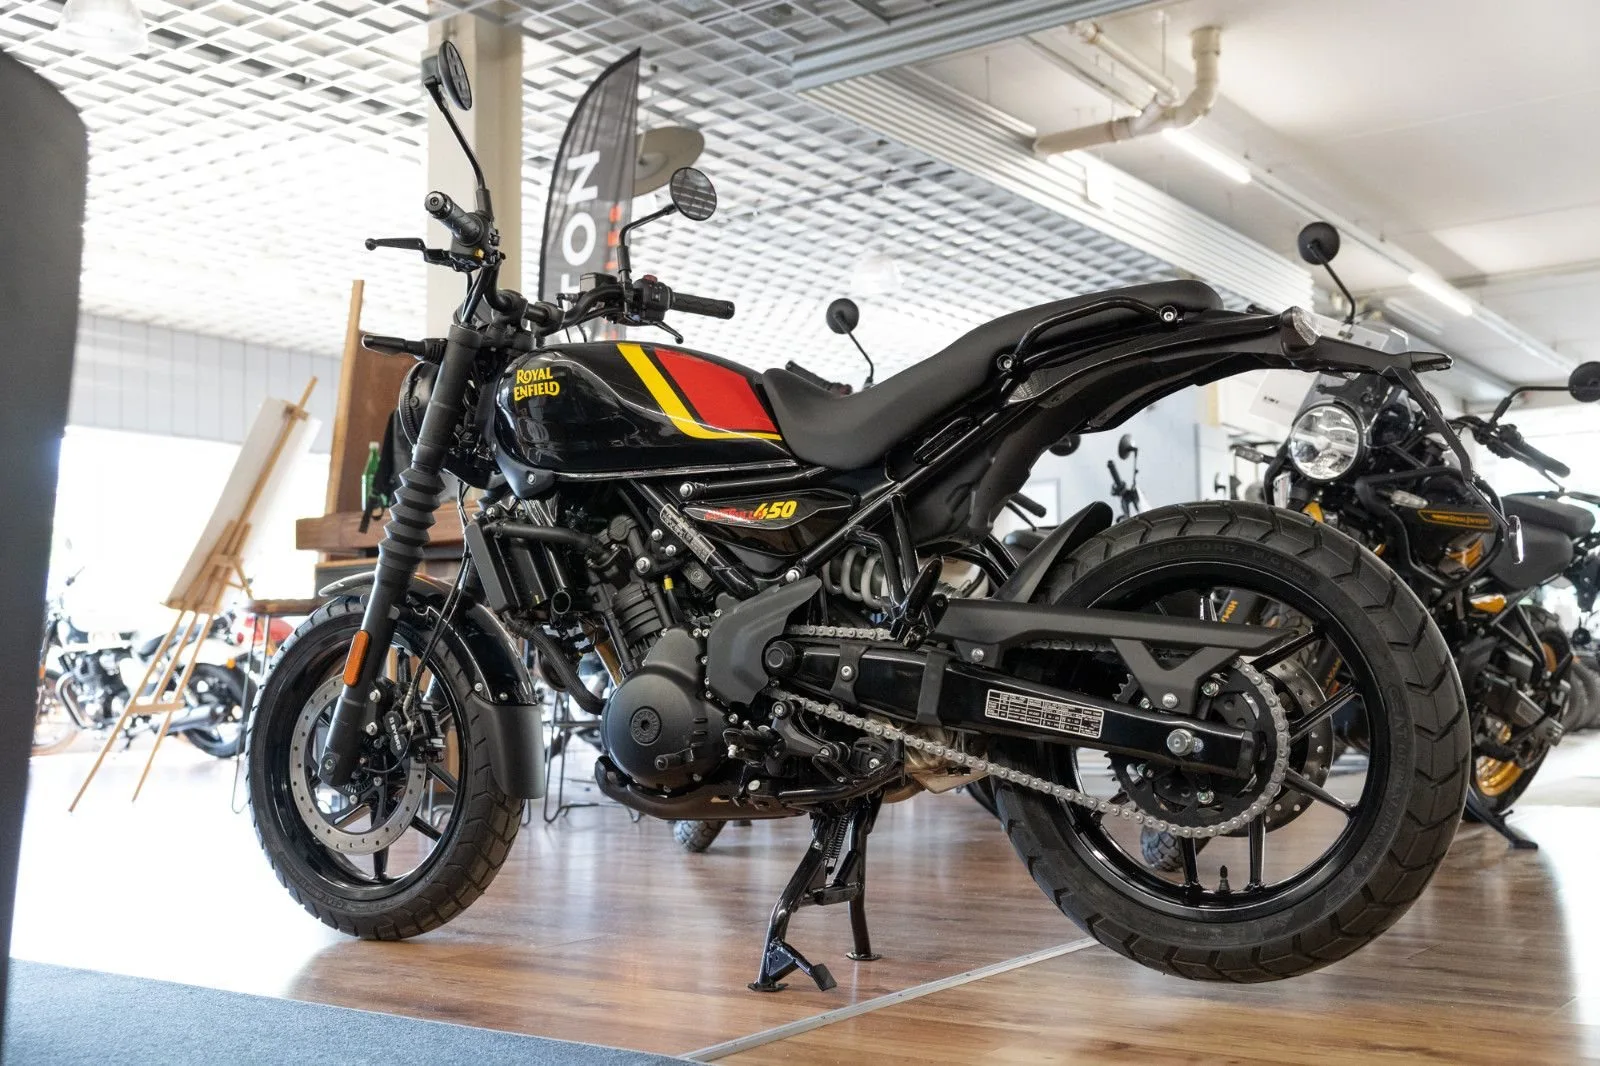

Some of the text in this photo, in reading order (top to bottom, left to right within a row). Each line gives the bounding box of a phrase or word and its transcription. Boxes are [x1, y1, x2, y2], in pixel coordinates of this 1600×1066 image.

[516, 367, 553, 384] ROYAL
[514, 381, 560, 401] ENFIELD
[753, 501, 798, 519] 450
